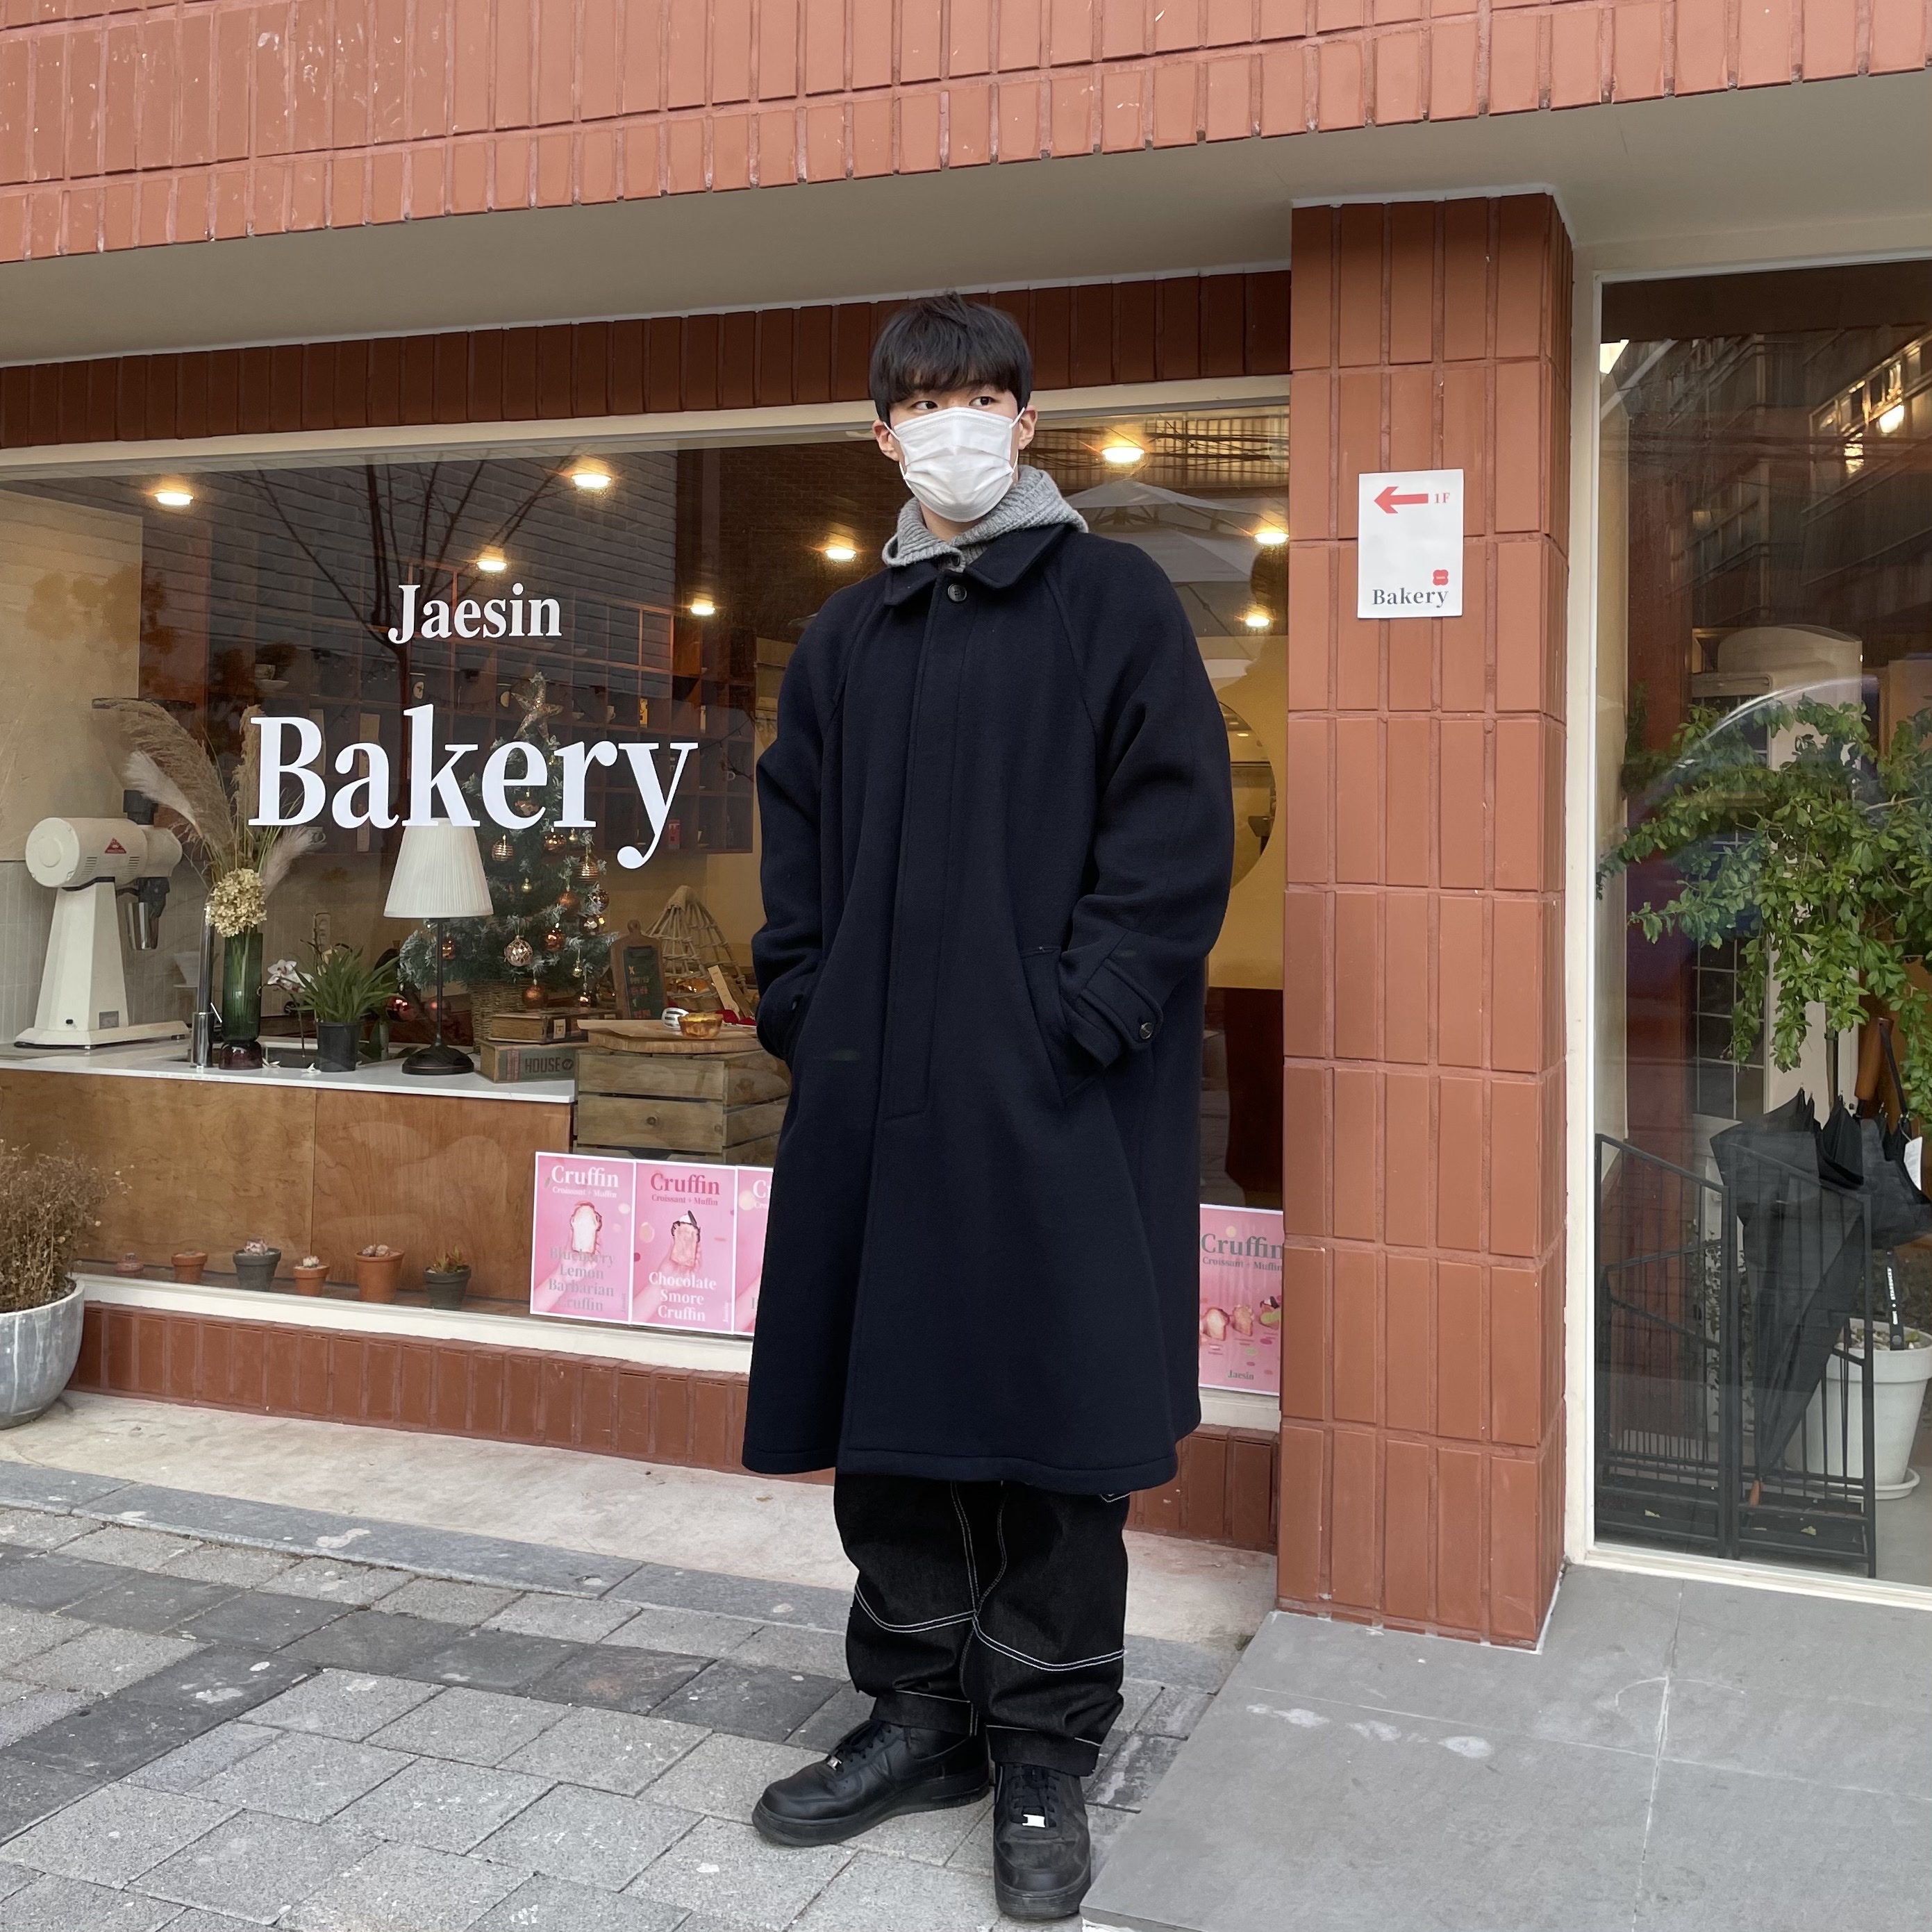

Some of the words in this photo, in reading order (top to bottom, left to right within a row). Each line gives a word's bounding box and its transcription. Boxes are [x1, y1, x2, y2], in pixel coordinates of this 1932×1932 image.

[1433, 492, 1451, 504] 1F
[1372, 587, 1449, 608] Bakery
[388, 582, 563, 645] Jaesin
[248, 703, 699, 870] Bakery
[524, 1056, 561, 1074] HOUSE
[551, 1165, 619, 1188] Cruffin
[650, 1172, 720, 1195] Cruffin
[593, 1189, 617, 1198] Muffin
[651, 1194, 685, 1204] Croissant
[694, 1197, 718, 1206] Muffin
[1201, 1233, 1282, 1259] Cruffin
[560, 1263, 604, 1280] Lemon
[1202, 1256, 1244, 1267] Croissant
[1253, 1260, 1282, 1272] Muffin
[649, 1272, 717, 1290] Chocolate
[557, 1297, 603, 1312] Cruffin
[660, 1289, 704, 1306] Smore
[657, 1304, 706, 1322] Cruffin
[1227, 1369, 1254, 1381] Jaesin
